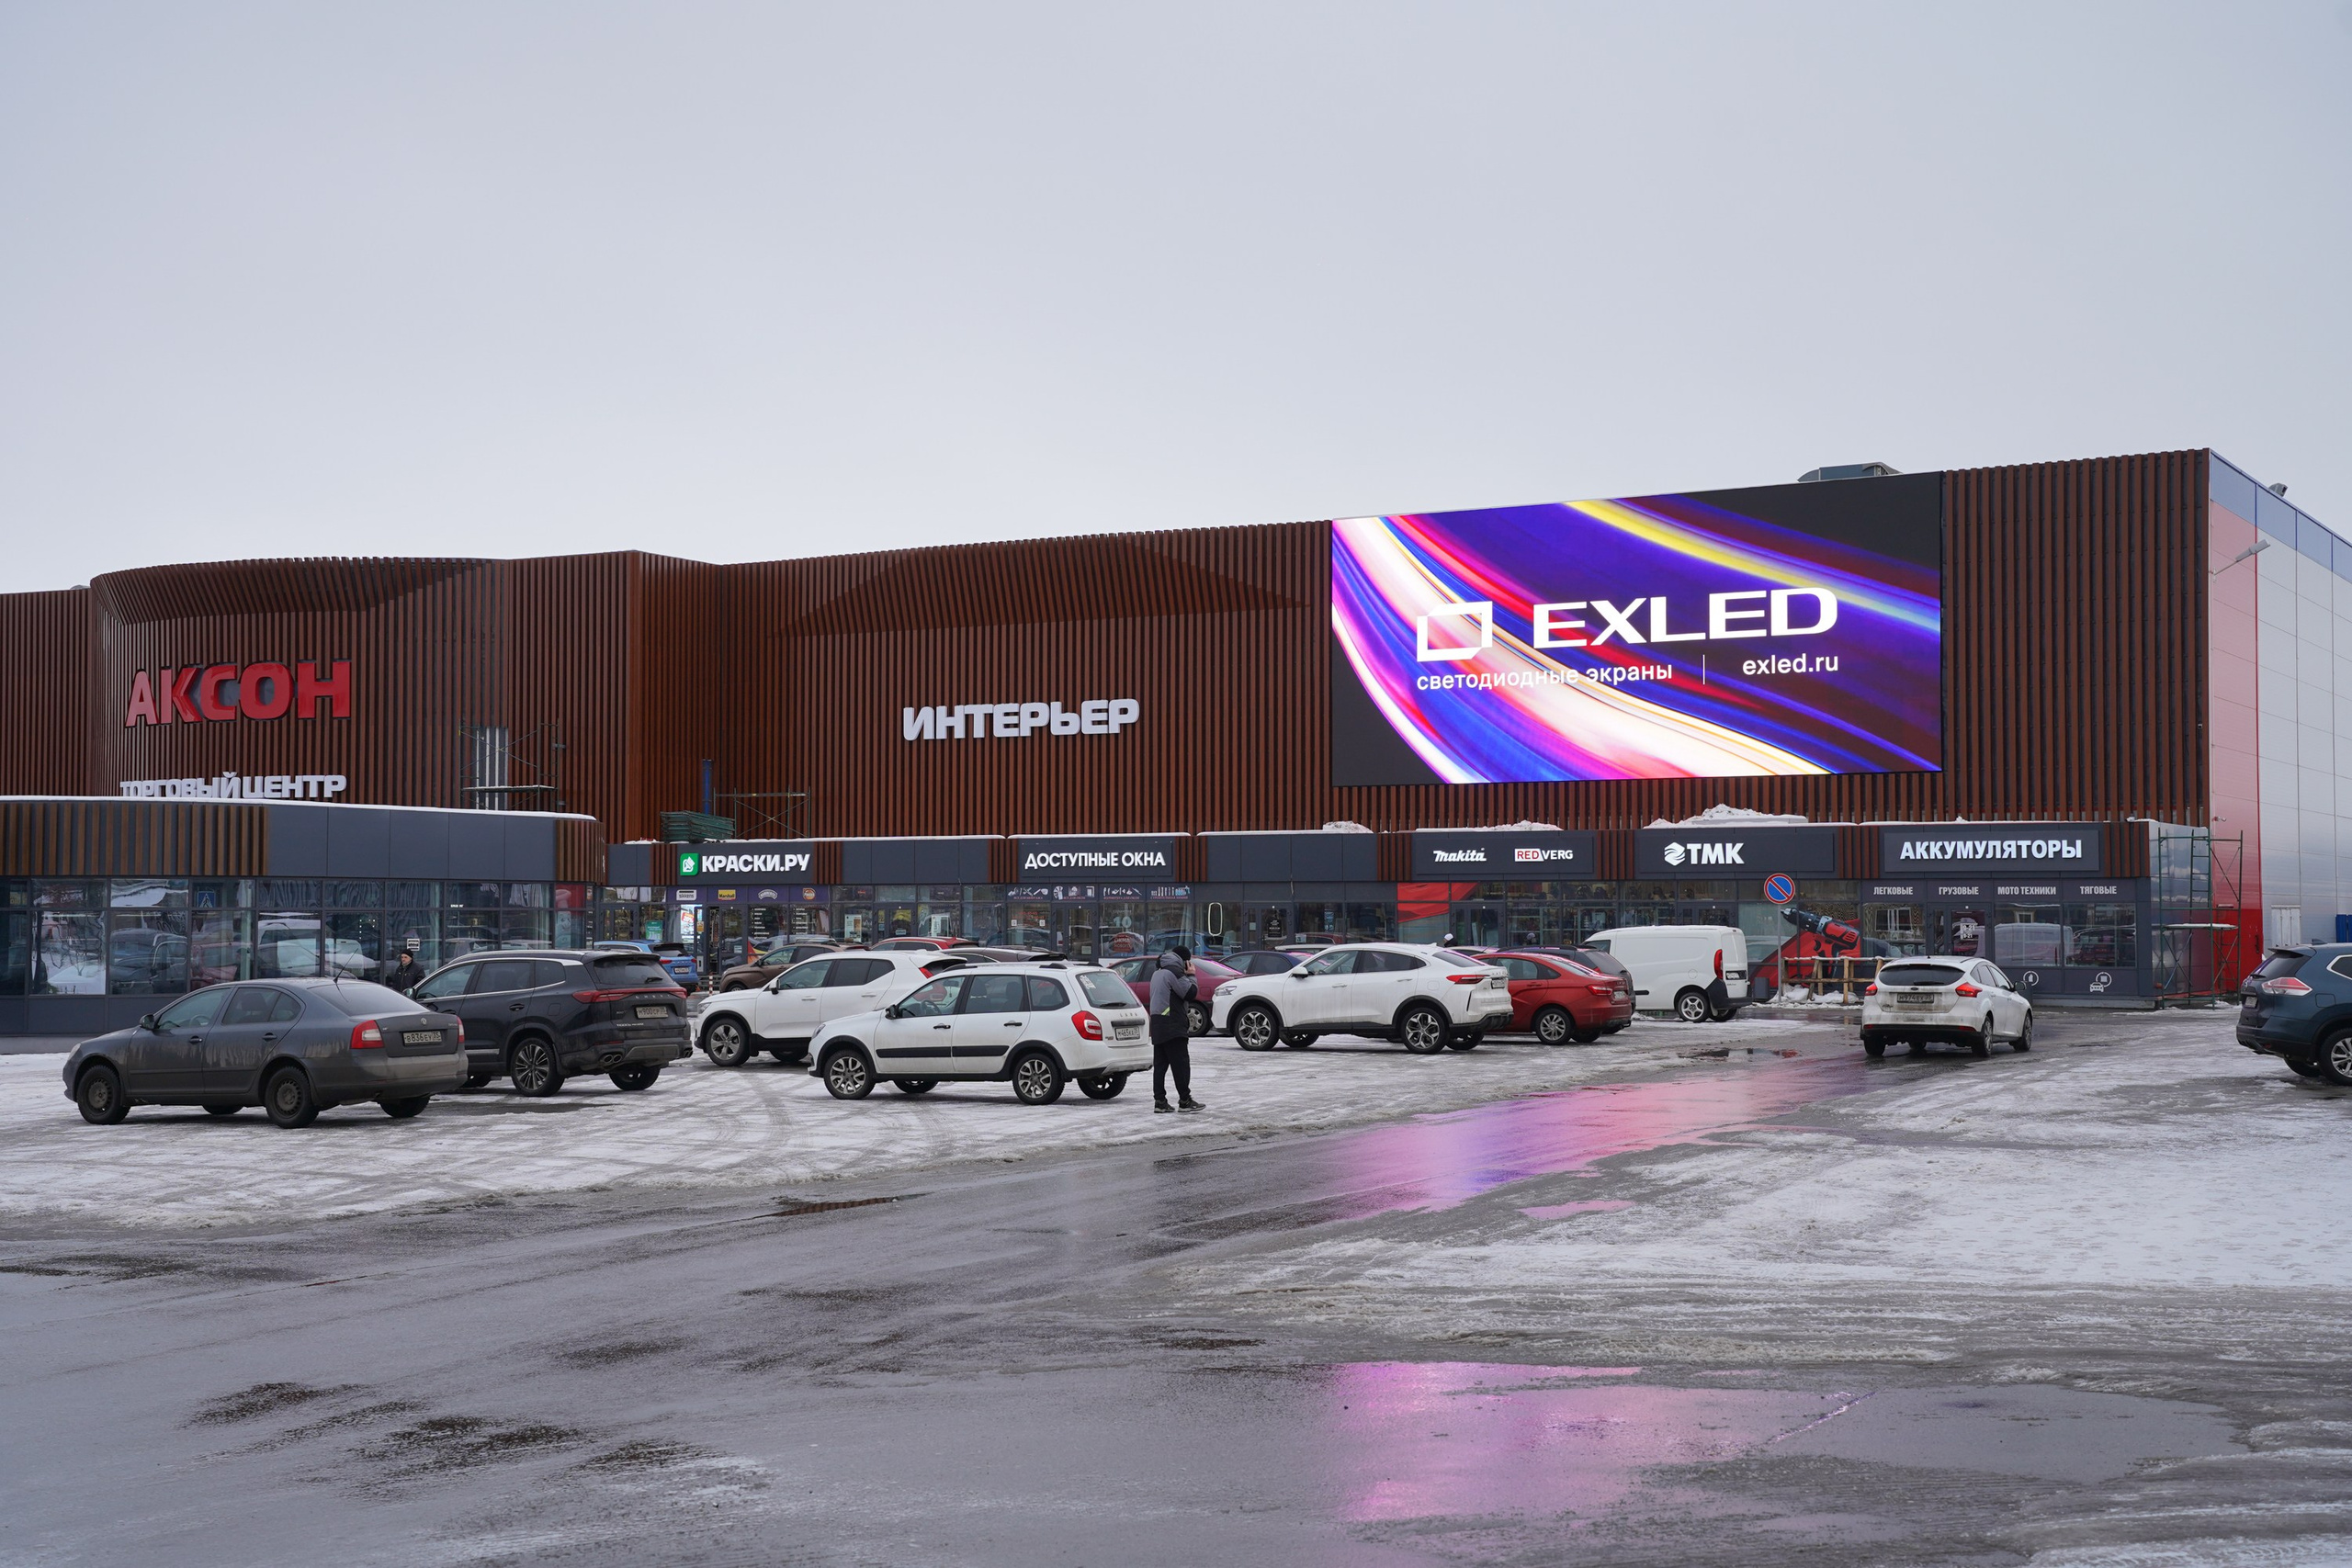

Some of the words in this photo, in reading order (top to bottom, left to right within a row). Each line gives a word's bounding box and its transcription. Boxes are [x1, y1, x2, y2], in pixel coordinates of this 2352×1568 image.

[1532, 587, 1838, 649] EXLED
[1742, 651, 1839, 677] exled.ru
[1416, 666, 1579, 692] светодиодные
[1586, 662, 1674, 686] экраны
[125, 658, 352, 728] АКСОН
[903, 698, 1140, 741] ИНТЕРЬЕР
[119, 771, 242, 798] ТОРГОВЫЙ
[243, 774, 347, 798] ЦЕНТР
[1899, 840, 2083, 860] АККУМУЛЯТОРЫ
[701, 853, 810, 873] КРАСКИ.РУ
[1024, 852, 1119, 870] ДОСТУПНЫЕ
[1121, 852, 1166, 867] ОКНА
[1873, 886, 1914, 896] ЛЕГКОВЫЕ
[1939, 886, 1979, 896] ГРУЗОВЫЕ
[1997, 886, 2019, 896] МОТО
[2020, 886, 2056, 895] ТЕХНИКИ
[2079, 886, 2117, 895] ТЯГОВЫЕ
